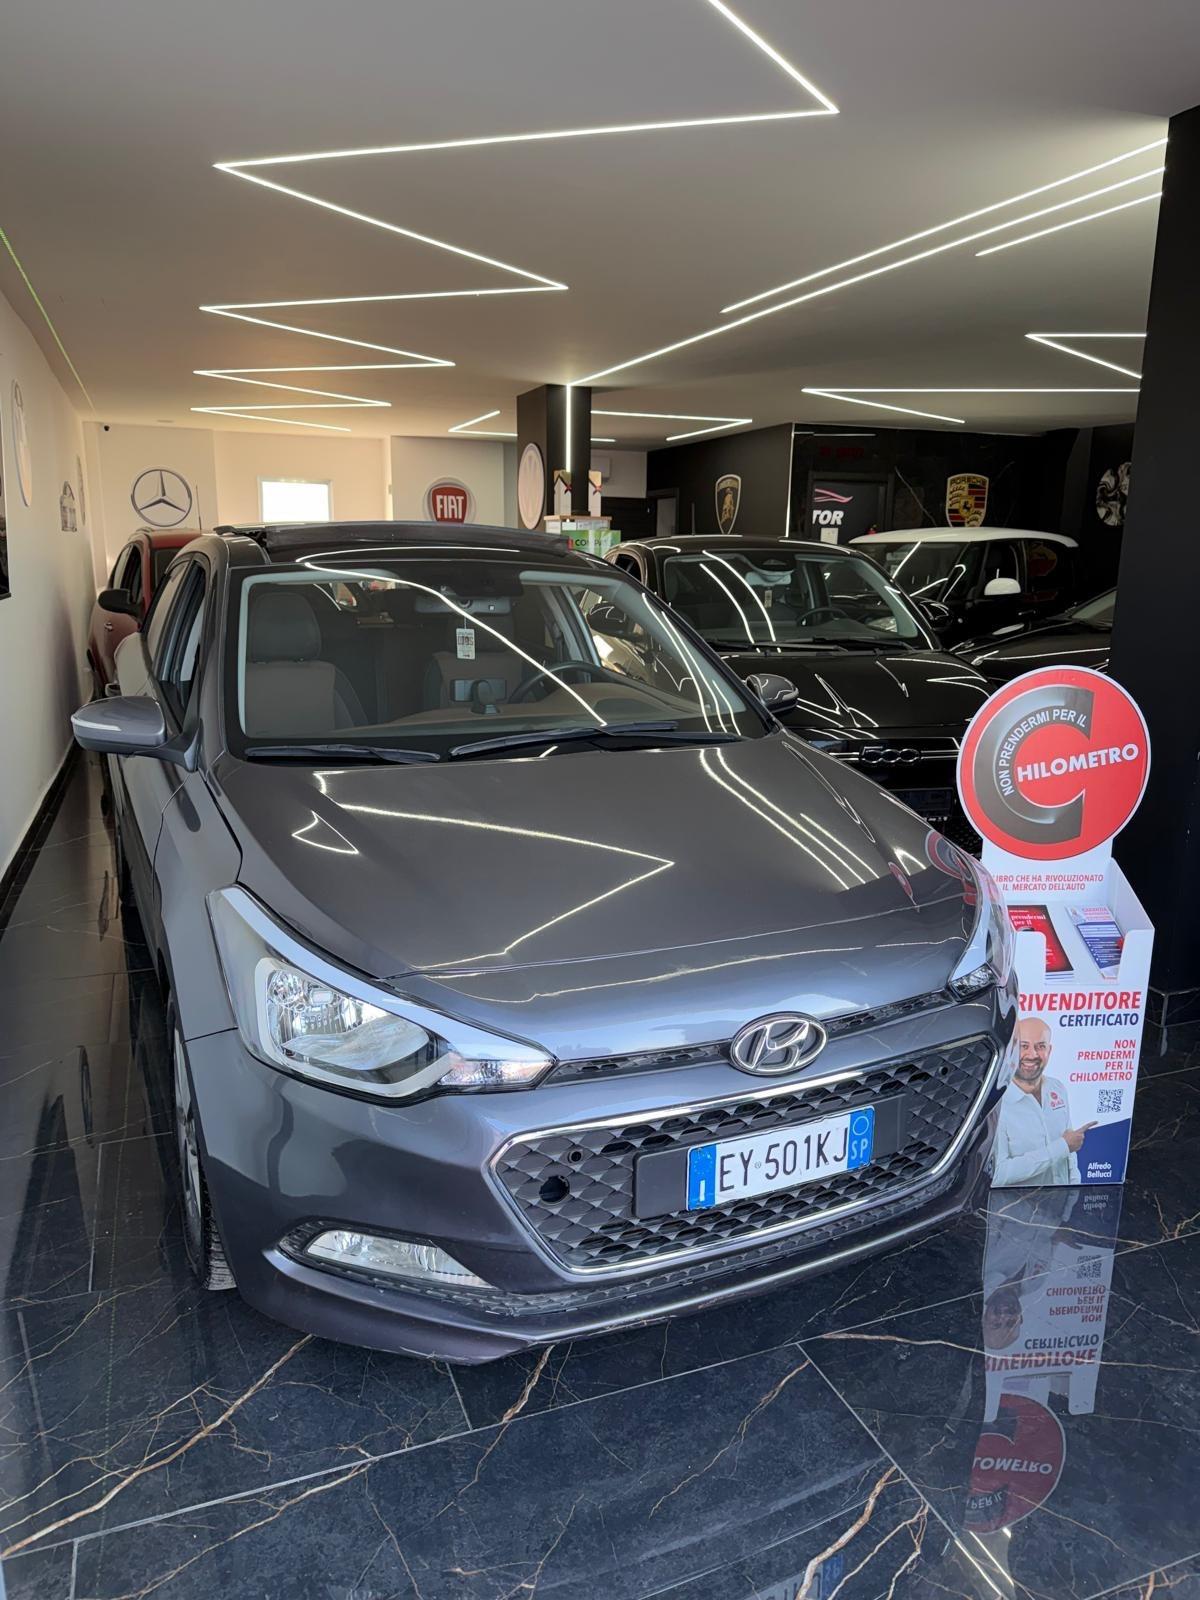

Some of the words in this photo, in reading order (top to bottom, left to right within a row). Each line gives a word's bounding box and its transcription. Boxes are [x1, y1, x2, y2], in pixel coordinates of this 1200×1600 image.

[436, 495, 464, 519] FIAT
[1052, 709, 1076, 721] PER
[1077, 714, 1090, 728] IL
[998, 711, 1050, 767] PRENDERMI
[861, 746, 919, 764] 500
[998, 769, 1014, 796] NON
[993, 874, 1013, 882] IBRO
[1045, 874, 1104, 882] RIVOLUZIONATO
[1003, 883, 1009, 891] IL
[1012, 883, 1047, 891] MERCATO
[1048, 883, 1086, 891] DELL'AUTO
[1018, 991, 1141, 1011] RIVENDITORE
[1059, 1013, 1139, 1027] CERTIFICATO
[1114, 1040, 1136, 1049] NON
[1078, 1050, 1135, 1061] PRENDERMI
[1105, 1061, 1124, 1070] PER
[1125, 1061, 1134, 1070] IL
[1070, 1072, 1132, 1082] CHILOMETRO
[851, 1138, 868, 1160] SP
[719, 1149, 754, 1192] EY
[764, 1127, 848, 1180] 501KJ
[1087, 1161, 1112, 1170] Alfredo
[1087, 1170, 1112, 1178] Bellucci
